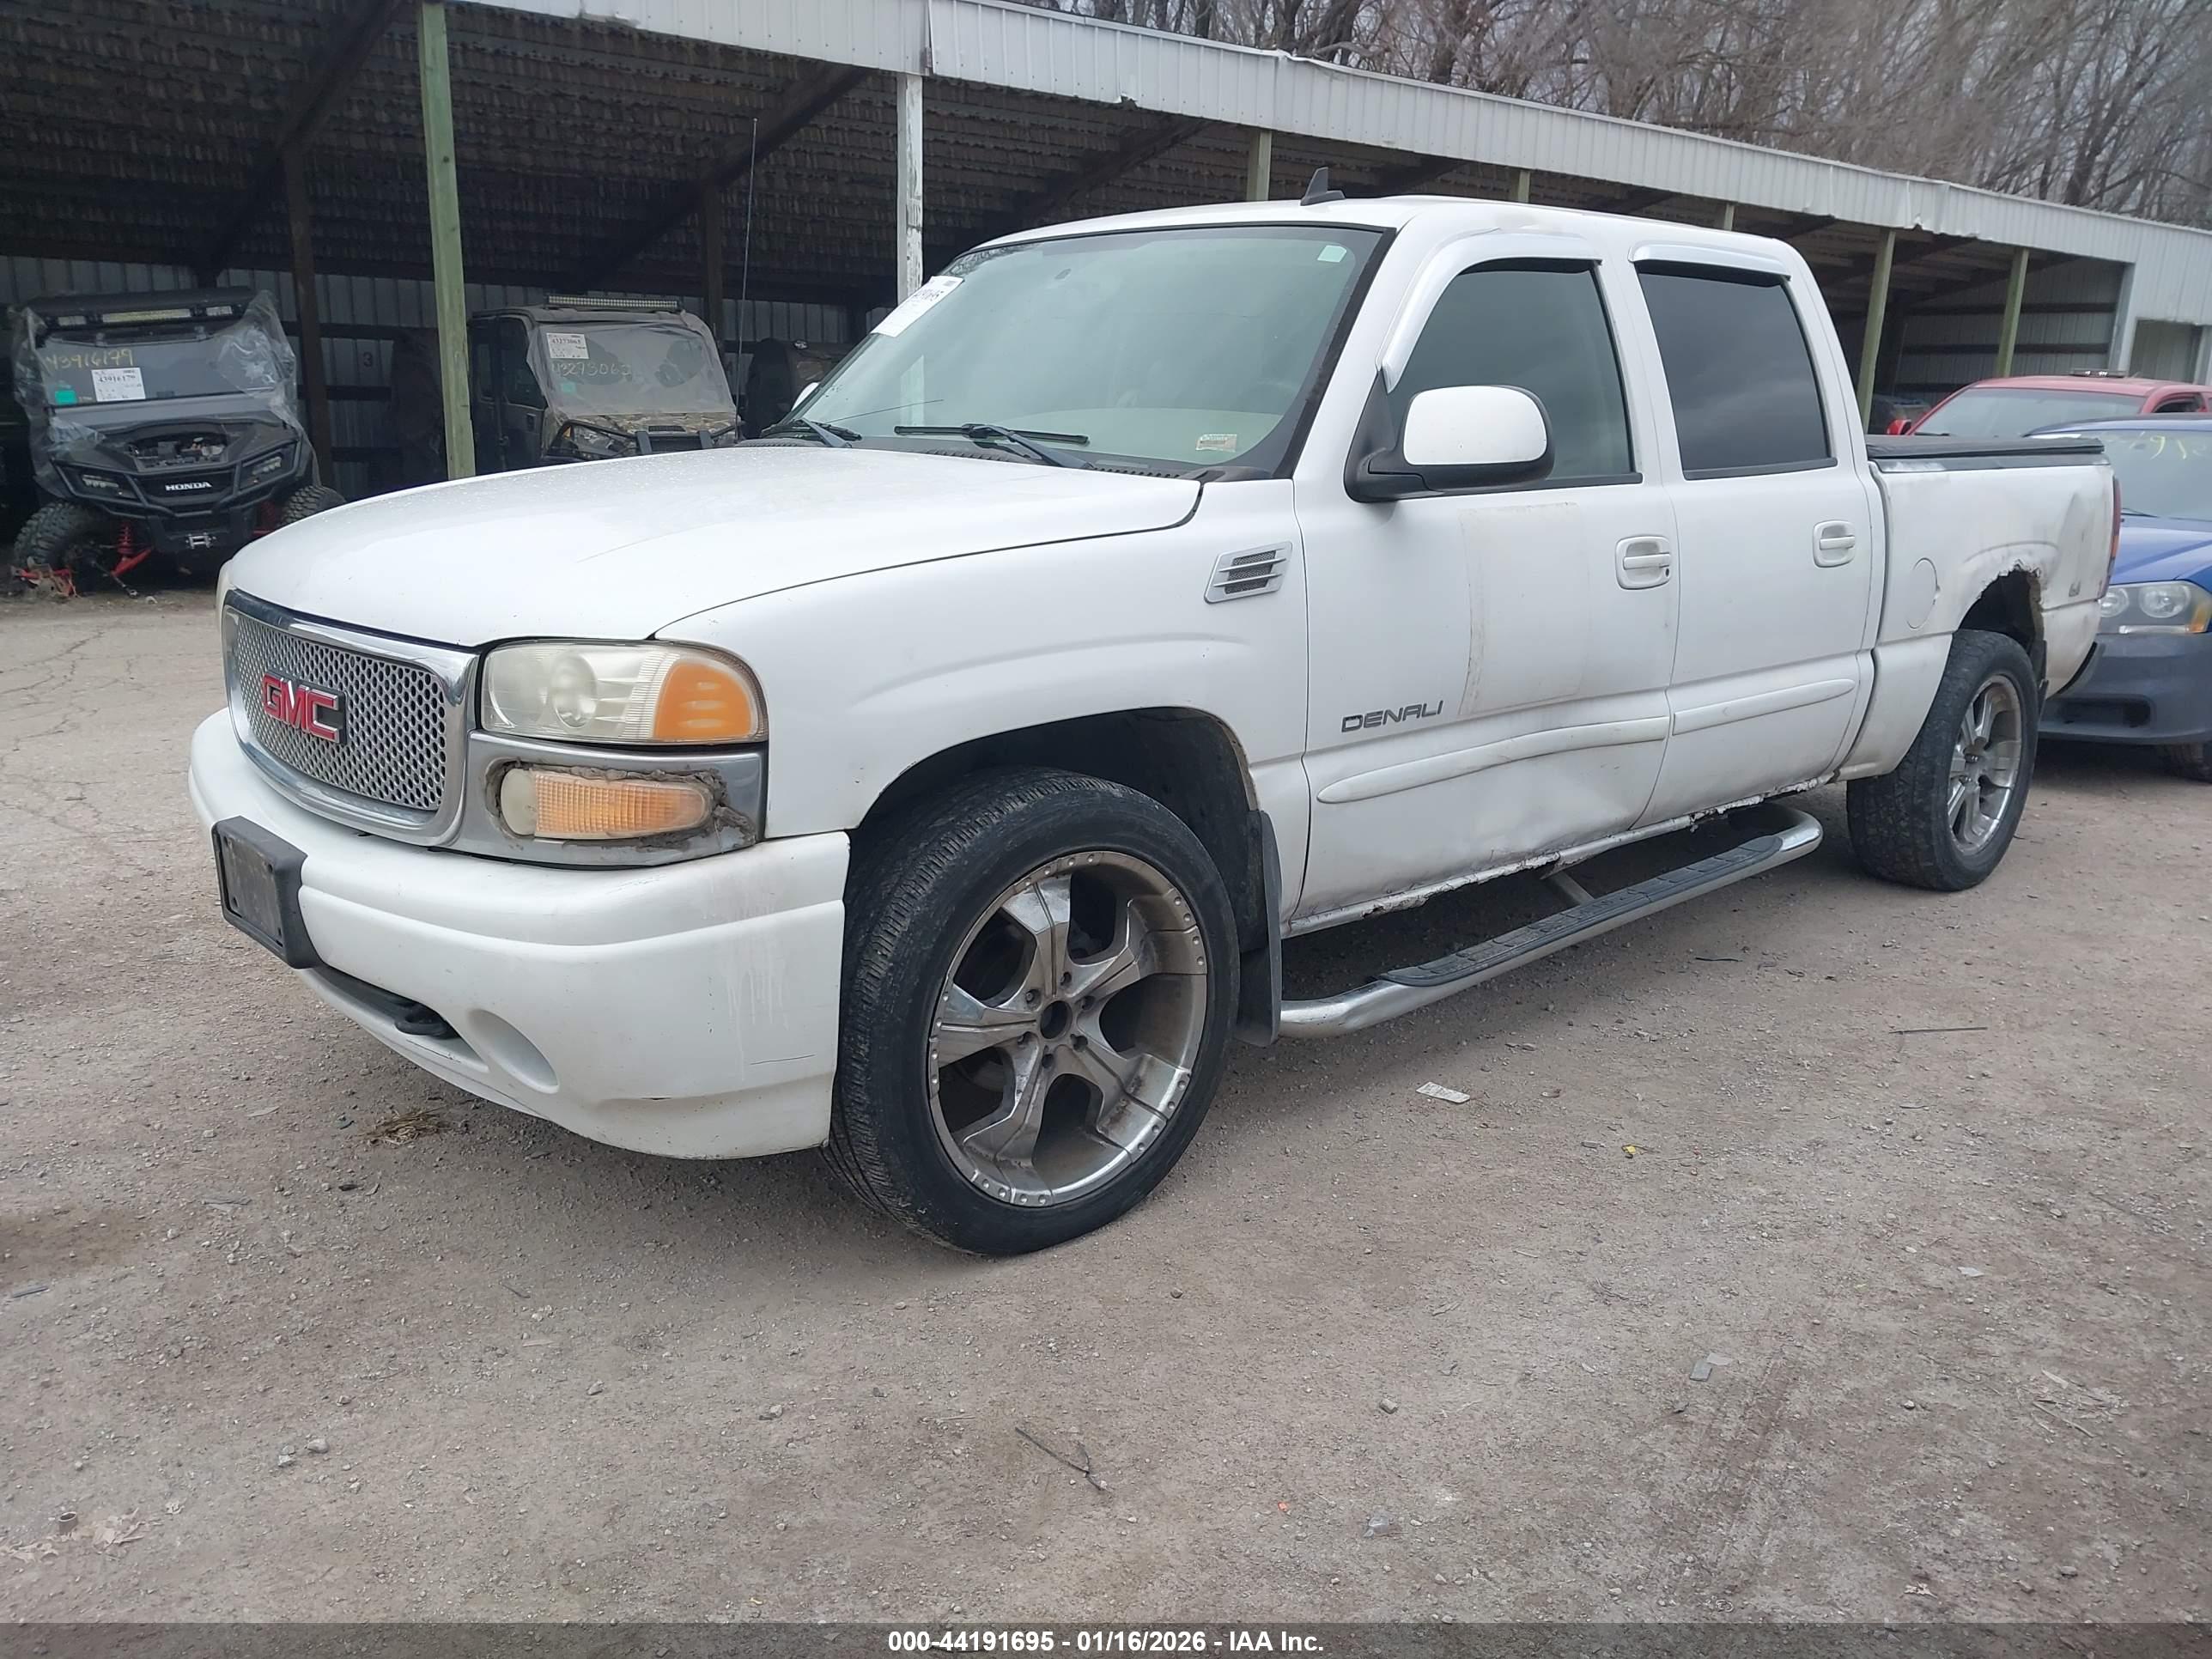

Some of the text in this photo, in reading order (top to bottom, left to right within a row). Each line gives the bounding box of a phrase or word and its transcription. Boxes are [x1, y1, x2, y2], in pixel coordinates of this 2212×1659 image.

[46, 348, 134, 370] 43916179
[165, 481, 213, 491] HONDA
[263, 672, 340, 744] GMC
[1341, 700, 1443, 733] DENALI
